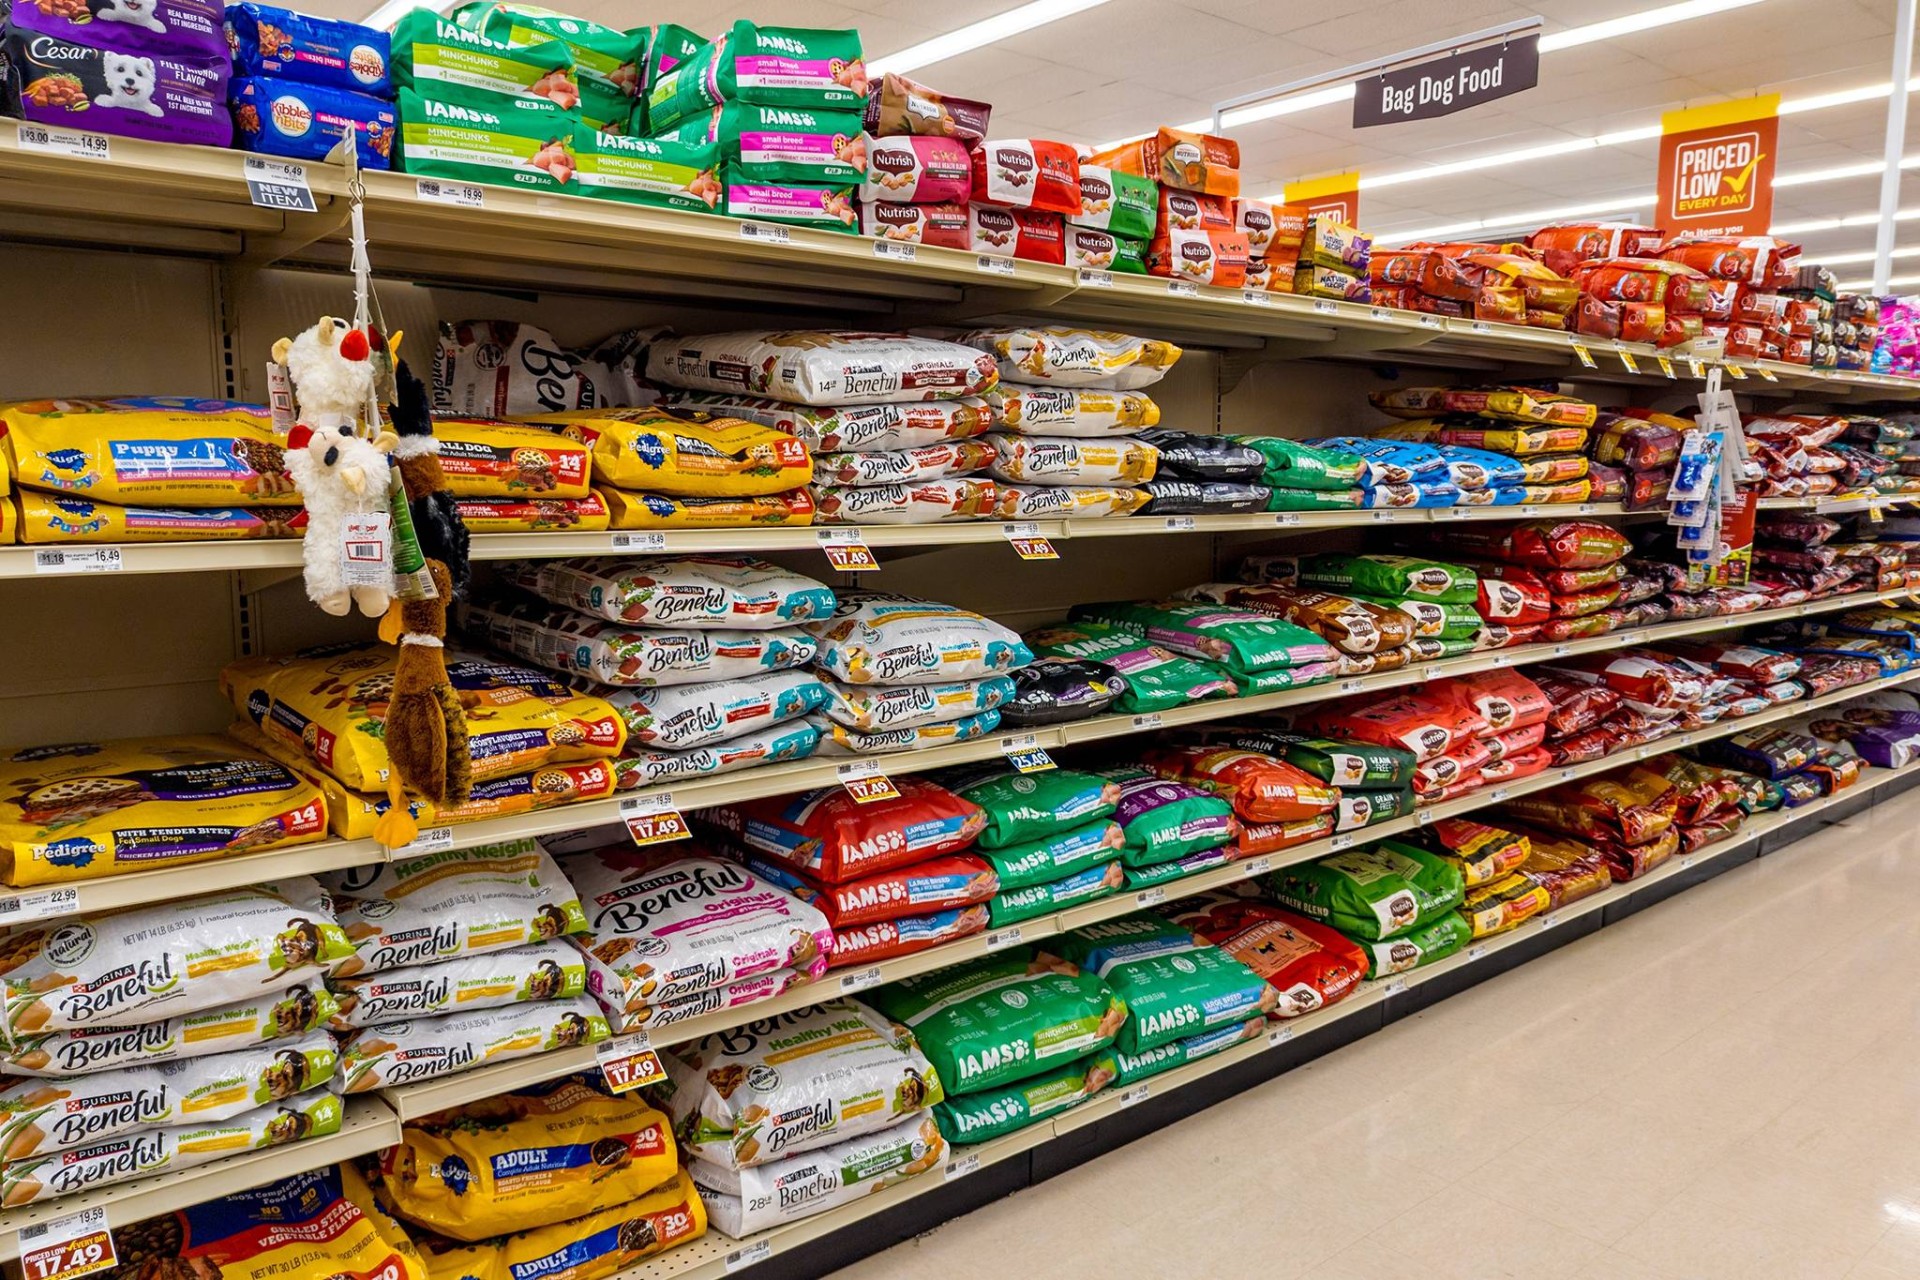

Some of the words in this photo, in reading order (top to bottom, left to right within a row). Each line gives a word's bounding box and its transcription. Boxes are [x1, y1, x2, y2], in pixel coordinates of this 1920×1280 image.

[168, 9, 183, 18] REAL
[184, 13, 197, 22] BEEF
[170, 18, 180, 26] 1ST
[181, 20, 213, 34] INGREDIENT
[30, 37, 93, 61] Cesar
[438, 48, 500, 69] MINICHUNKS
[757, 59, 775, 70] small
[776, 61, 799, 71] breed
[175, 71, 206, 87] FLAVOR
[1382, 83, 1415, 115] Bag
[1418, 75, 1454, 106] Dog
[1459, 58, 1503, 95] Food
[166, 93, 181, 102] REAL
[180, 104, 213, 116] INGREDIENT
[270, 102, 312, 120] Kibbles
[425, 100, 482, 121] IAMS
[539, 103, 555, 112] BAG
[760, 108, 802, 127] IAMS
[25, 130, 49, 144] $3.00
[428, 128, 491, 142] MINICHUNKS
[761, 135, 780, 145] small
[781, 136, 803, 146] breed
[81, 136, 108, 152] 14.99
[440, 149, 478, 163] INGREDIENT
[479, 155, 485, 163] IS
[488, 156, 514, 166] CHICKEN
[597, 157, 654, 171] MINICHUNKS
[876, 152, 914, 167] Nutrish
[1000, 152, 1031, 168] Nutrish
[1681, 141, 1751, 175] PRICED
[283, 164, 302, 178] 6.49
[259, 183, 298, 196] NEW
[463, 187, 482, 200] 19.99
[749, 189, 770, 199] small
[771, 190, 793, 200] breed
[1679, 173, 1723, 200] LOW
[260, 193, 303, 208] ITEM
[1678, 196, 1718, 211] EVERY
[1720, 192, 1747, 207] DAY
[878, 206, 917, 220] Nutrish
[980, 212, 1012, 227] Nutrish
[1695, 226, 1721, 237] items
[1722, 225, 1743, 236] you
[1079, 236, 1112, 249] Nutrish
[1184, 246, 1211, 259] Nutrish
[844, 372, 898, 392] Beneful
[1026, 393, 1075, 421] Beneful
[115, 444, 178, 458] Puppy
[463, 442, 492, 453] DOG
[629, 440, 670, 455] Pedigree
[782, 441, 803, 455] 14
[559, 454, 581, 471] 14
[1029, 447, 1078, 471] Beneful
[40, 469, 94, 490] Puppy
[848, 487, 904, 511] Beneful
[983, 488, 994, 498] 14
[1022, 491, 1071, 513] Beneful
[1018, 542, 1049, 554] 17.49
[40, 552, 64, 564] $1.18
[94, 550, 120, 563] 16.49
[833, 552, 869, 565] 17.49
[1425, 573, 1447, 584] Nutrish
[655, 593, 725, 618] Beneful
[821, 595, 833, 607] 14
[648, 644, 712, 672] Beneful
[876, 648, 935, 679] Beneful
[809, 688, 822, 701] 14
[878, 693, 931, 724] Beneful
[522, 730, 543, 740] BITES
[591, 721, 614, 735] 18
[1237, 739, 1273, 751] GRAIN
[1014, 753, 1049, 768] 25.49
[582, 769, 603, 785] 18
[852, 783, 888, 796] 17.49
[1376, 793, 1395, 803] GRAIN
[289, 806, 317, 824] 14
[116, 829, 146, 837] WITH
[149, 828, 194, 836] TENDER
[196, 827, 231, 836] BITES
[432, 830, 450, 841] 22.99
[635, 820, 679, 838] 17.49
[906, 825, 925, 835] LARGE
[926, 821, 945, 831] BREED
[134, 835, 160, 844] Small
[162, 834, 183, 843] Dogs
[32, 842, 106, 861] Pedigree
[119, 850, 152, 859] CHICKEN
[161, 848, 186, 858] STEAK
[187, 846, 218, 855] FLAVOR
[842, 833, 890, 864] IAMS
[618, 874, 685, 899] PURINA
[909, 880, 928, 888] LARGE
[930, 877, 950, 885] BREED
[51, 890, 76, 902] 22.99
[594, 864, 745, 935] Beneful
[704, 891, 775, 912] Originals
[839, 882, 888, 912] IAMS
[1002, 890, 1031, 909] IAMS
[391, 928, 432, 942] PURINA
[371, 922, 457, 970] Beneful
[88, 965, 132, 990] PURINA
[568, 974, 582, 986] 14
[60, 953, 173, 1022] Beneful
[382, 981, 420, 994] PURINA
[362, 976, 447, 1020] Beneful
[1202, 997, 1222, 1008] LARGE
[1223, 993, 1242, 1003] BREED
[183, 1012, 224, 1027] Healthy
[1139, 1009, 1184, 1038] IAMS
[1036, 1022, 1079, 1039] MINICHUNKS
[57, 1022, 170, 1071] Beneful
[768, 1027, 830, 1051] Healthy
[314, 1055, 331, 1068] 14
[386, 1042, 474, 1085] Beneful
[958, 1044, 1014, 1078] IAMS
[611, 1060, 656, 1085] 17.49
[1027, 1080, 1069, 1100] MINICHUNKS
[81, 1092, 132, 1108] PURINA
[53, 1084, 167, 1146] Beneful
[315, 1108, 332, 1120] 14
[782, 1106, 813, 1122] PURINA
[955, 1100, 1001, 1133] IAMS
[767, 1098, 832, 1152] Beneful
[635, 1128, 657, 1143] 30
[78, 1141, 129, 1158] PURINA
[841, 1145, 880, 1165] HEALTHY
[51, 1132, 164, 1193] Beneful
[496, 1149, 548, 1168] ADULT
[779, 1172, 838, 1208] Beneful
[260, 1207, 280, 1215] NO
[749, 1198, 765, 1211] 28
[80, 1208, 103, 1224] 19.59
[270, 1223, 318, 1233] GRILLED
[321, 1200, 354, 1229] STEAK
[664, 1212, 686, 1229] 30
[73, 1238, 93, 1249] EVERY
[93, 1233, 107, 1243] DAY
[258, 1231, 328, 1248] VEGETABLE
[25, 1250, 50, 1264] PRICED
[50, 1245, 66, 1255] LOW
[34, 1247, 103, 1278] 17.49
[250, 1267, 266, 1280] NET
[267, 1265, 279, 1276] WT
[281, 1261, 289, 1272] 30
[290, 1257, 301, 1268] LB
[514, 1248, 569, 1280] ADULT
